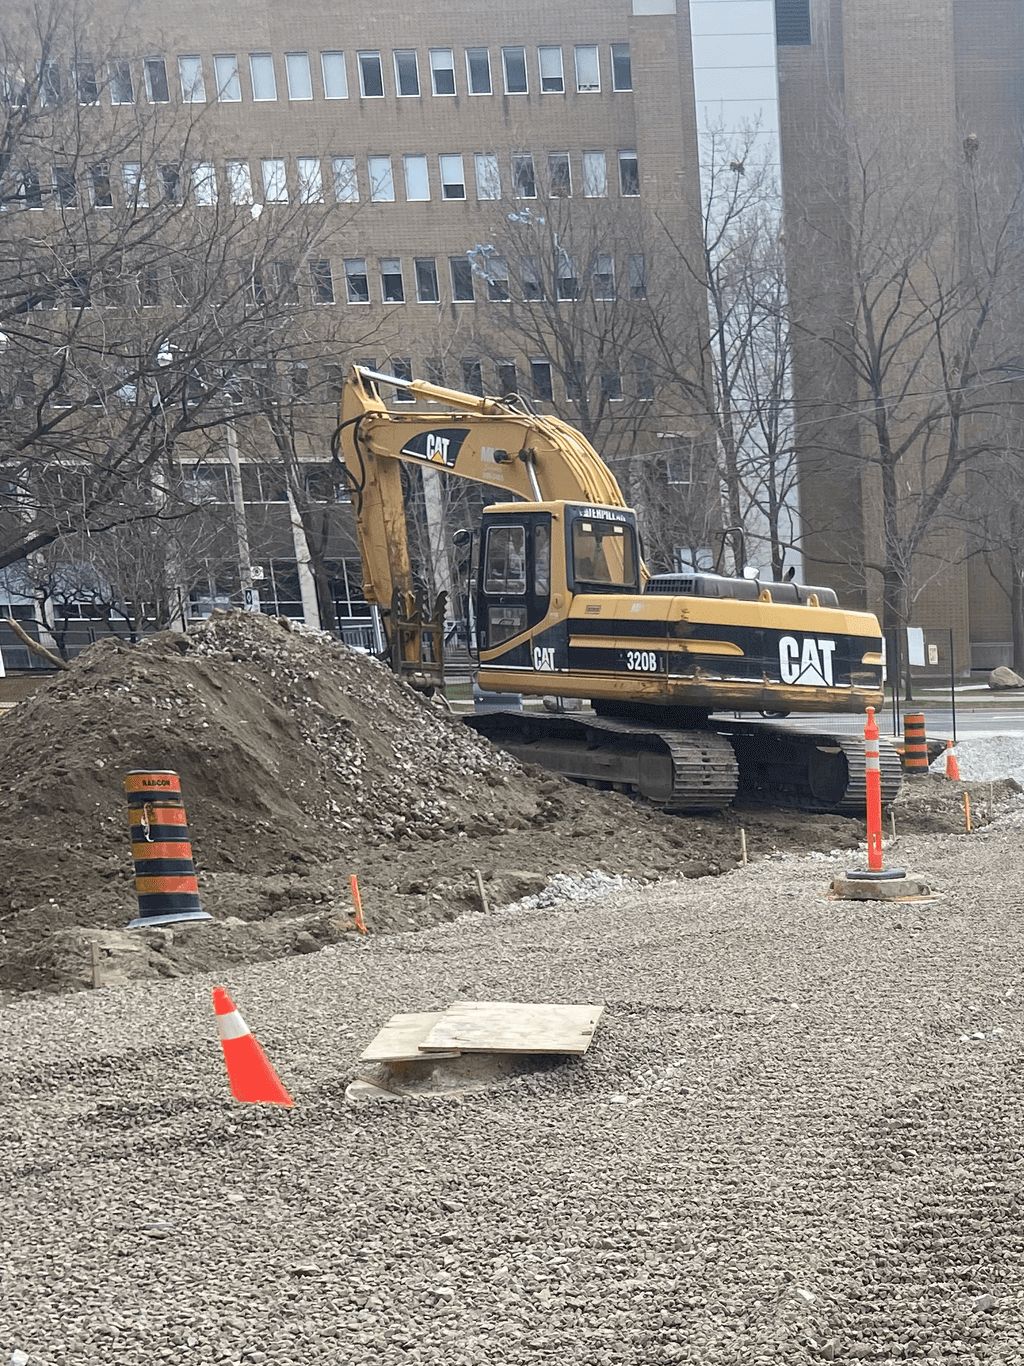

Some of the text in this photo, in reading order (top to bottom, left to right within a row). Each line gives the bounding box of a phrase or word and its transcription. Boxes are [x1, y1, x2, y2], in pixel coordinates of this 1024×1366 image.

[427, 434, 450, 465] CAT
[534, 647, 555, 671] CAT
[627, 651, 657, 671] 320B
[779, 636, 836, 687] CAT
